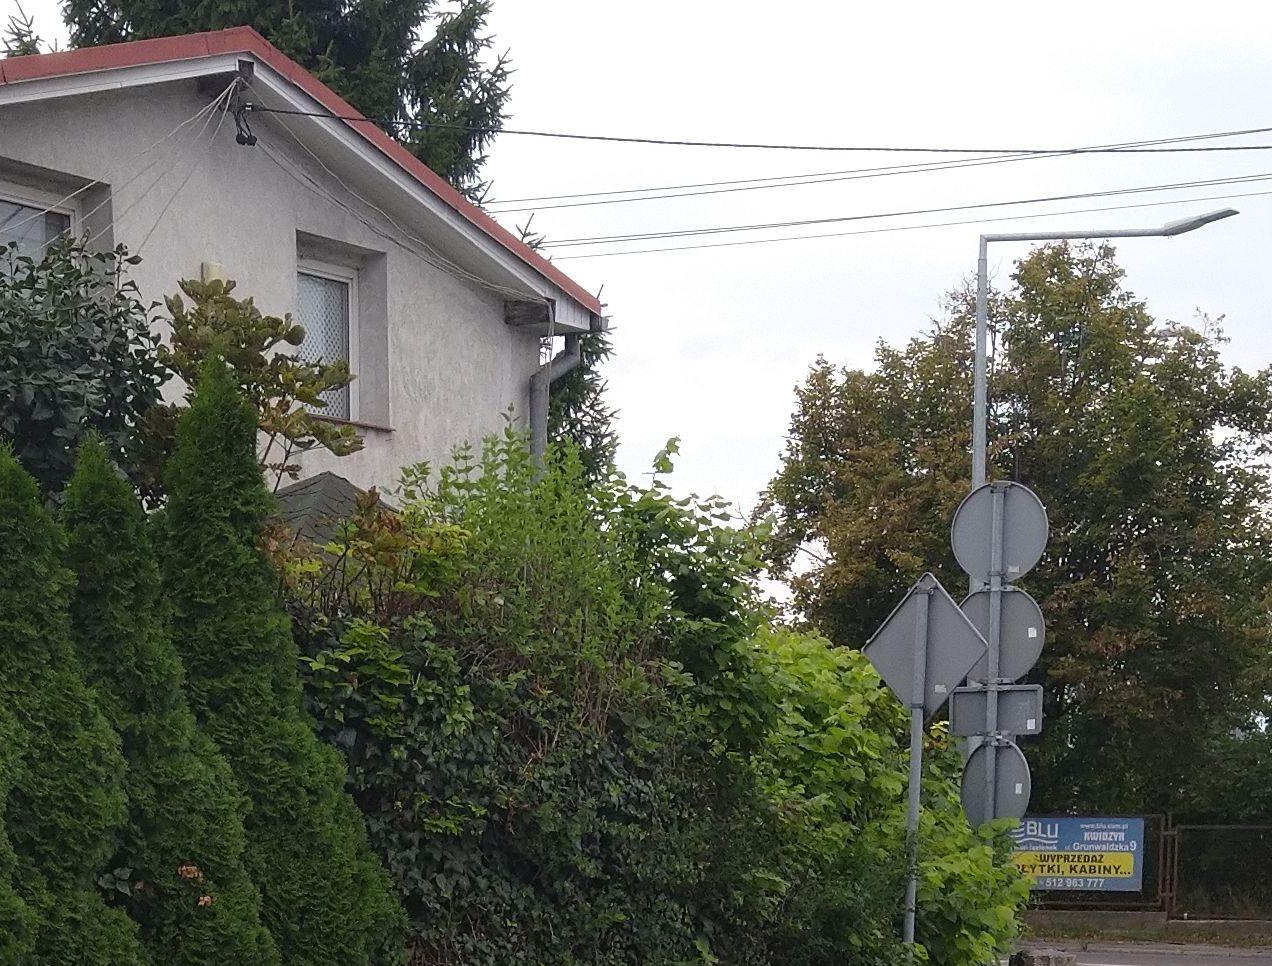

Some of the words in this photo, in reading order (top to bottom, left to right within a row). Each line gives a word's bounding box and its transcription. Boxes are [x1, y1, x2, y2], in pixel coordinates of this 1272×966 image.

[1026, 820, 1059, 838] BLU
[1084, 832, 1125, 841] KWIDZYN
[1072, 842, 1129, 851] Grunwaldzka
[1129, 840, 1137, 851] 9
[1069, 864, 1131, 875] KABINY...
[1045, 878, 1064, 887] 512
[1088, 879, 1105, 887] 777
